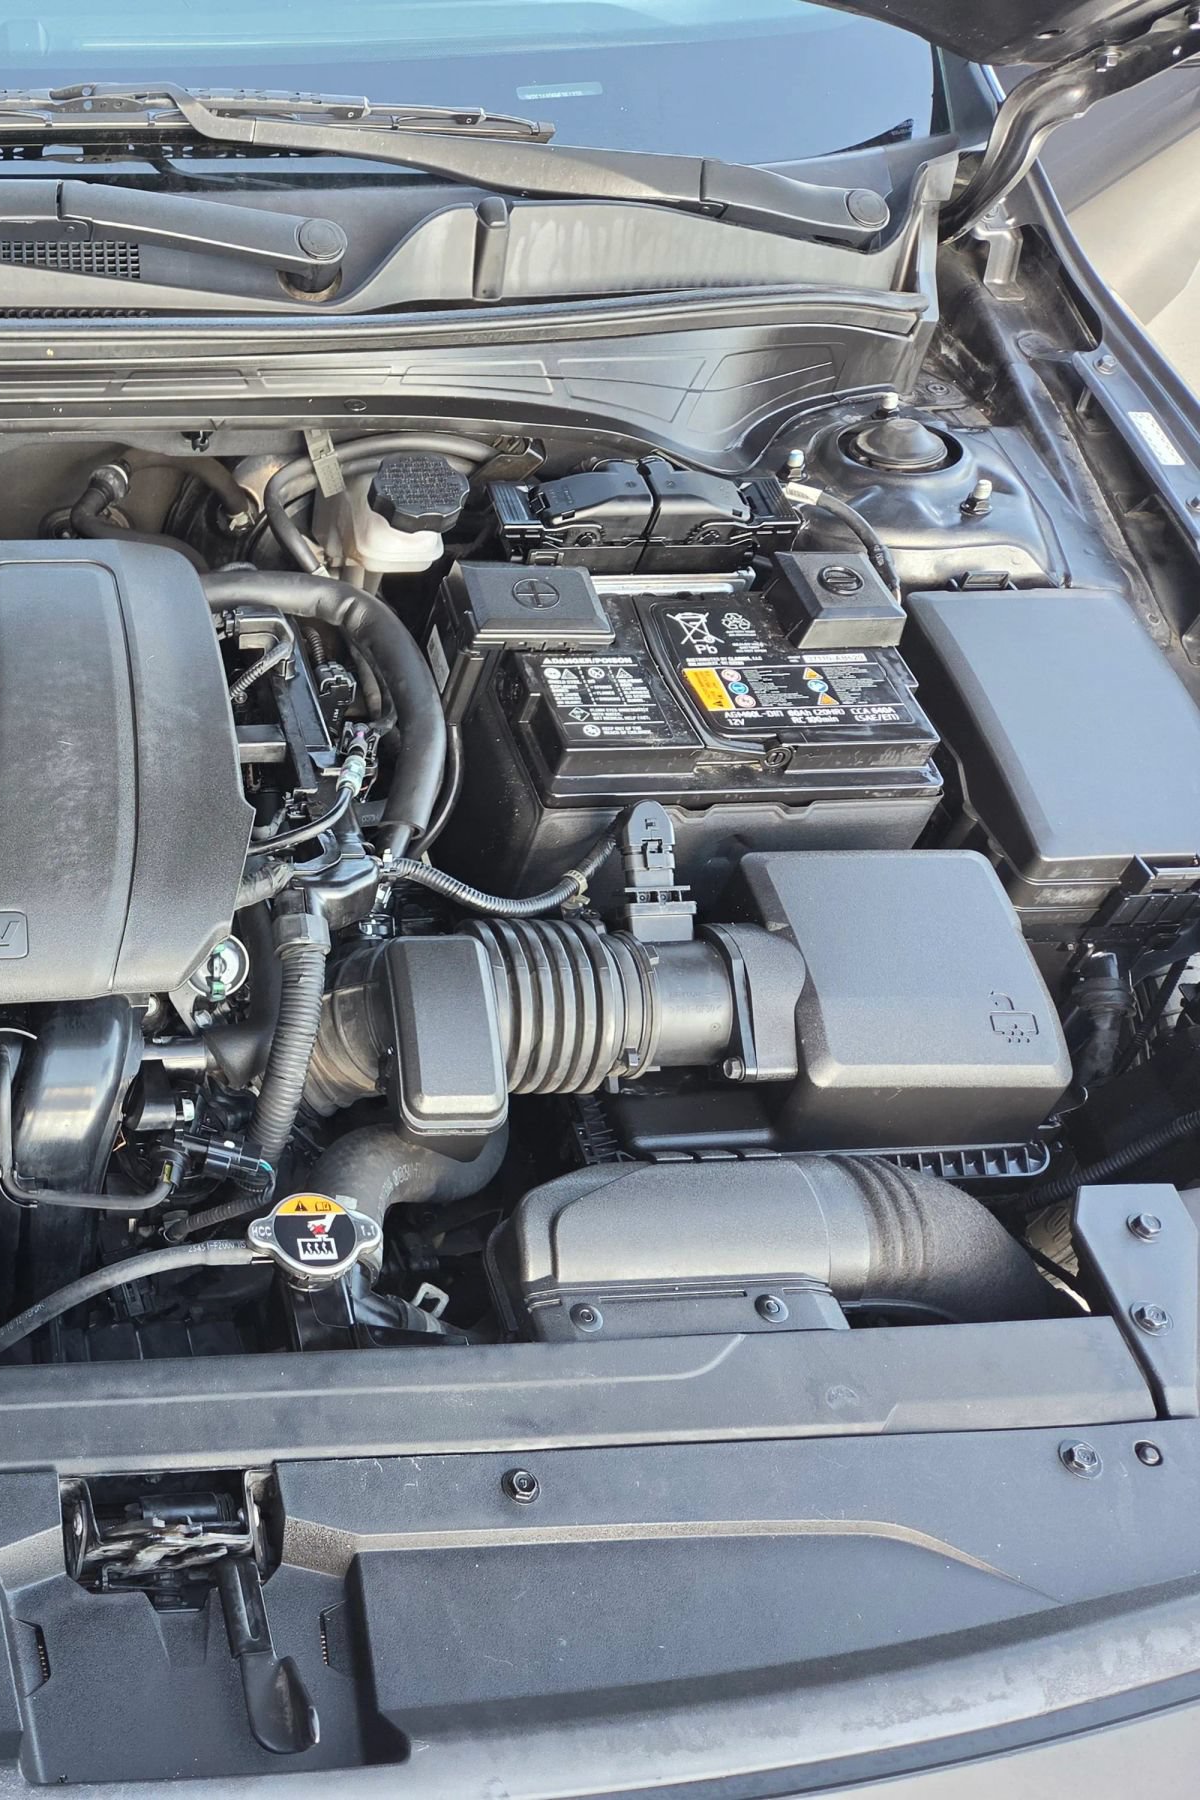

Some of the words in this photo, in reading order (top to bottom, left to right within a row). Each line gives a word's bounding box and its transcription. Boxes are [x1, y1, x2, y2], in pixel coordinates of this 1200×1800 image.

[695, 644, 718, 654] Pb
[787, 709, 812, 717] 60Ah
[850, 707, 871, 715] CCA
[727, 718, 745, 726] 12V
[791, 716, 806, 724] RC
[251, 1225, 273, 1237] HCC
